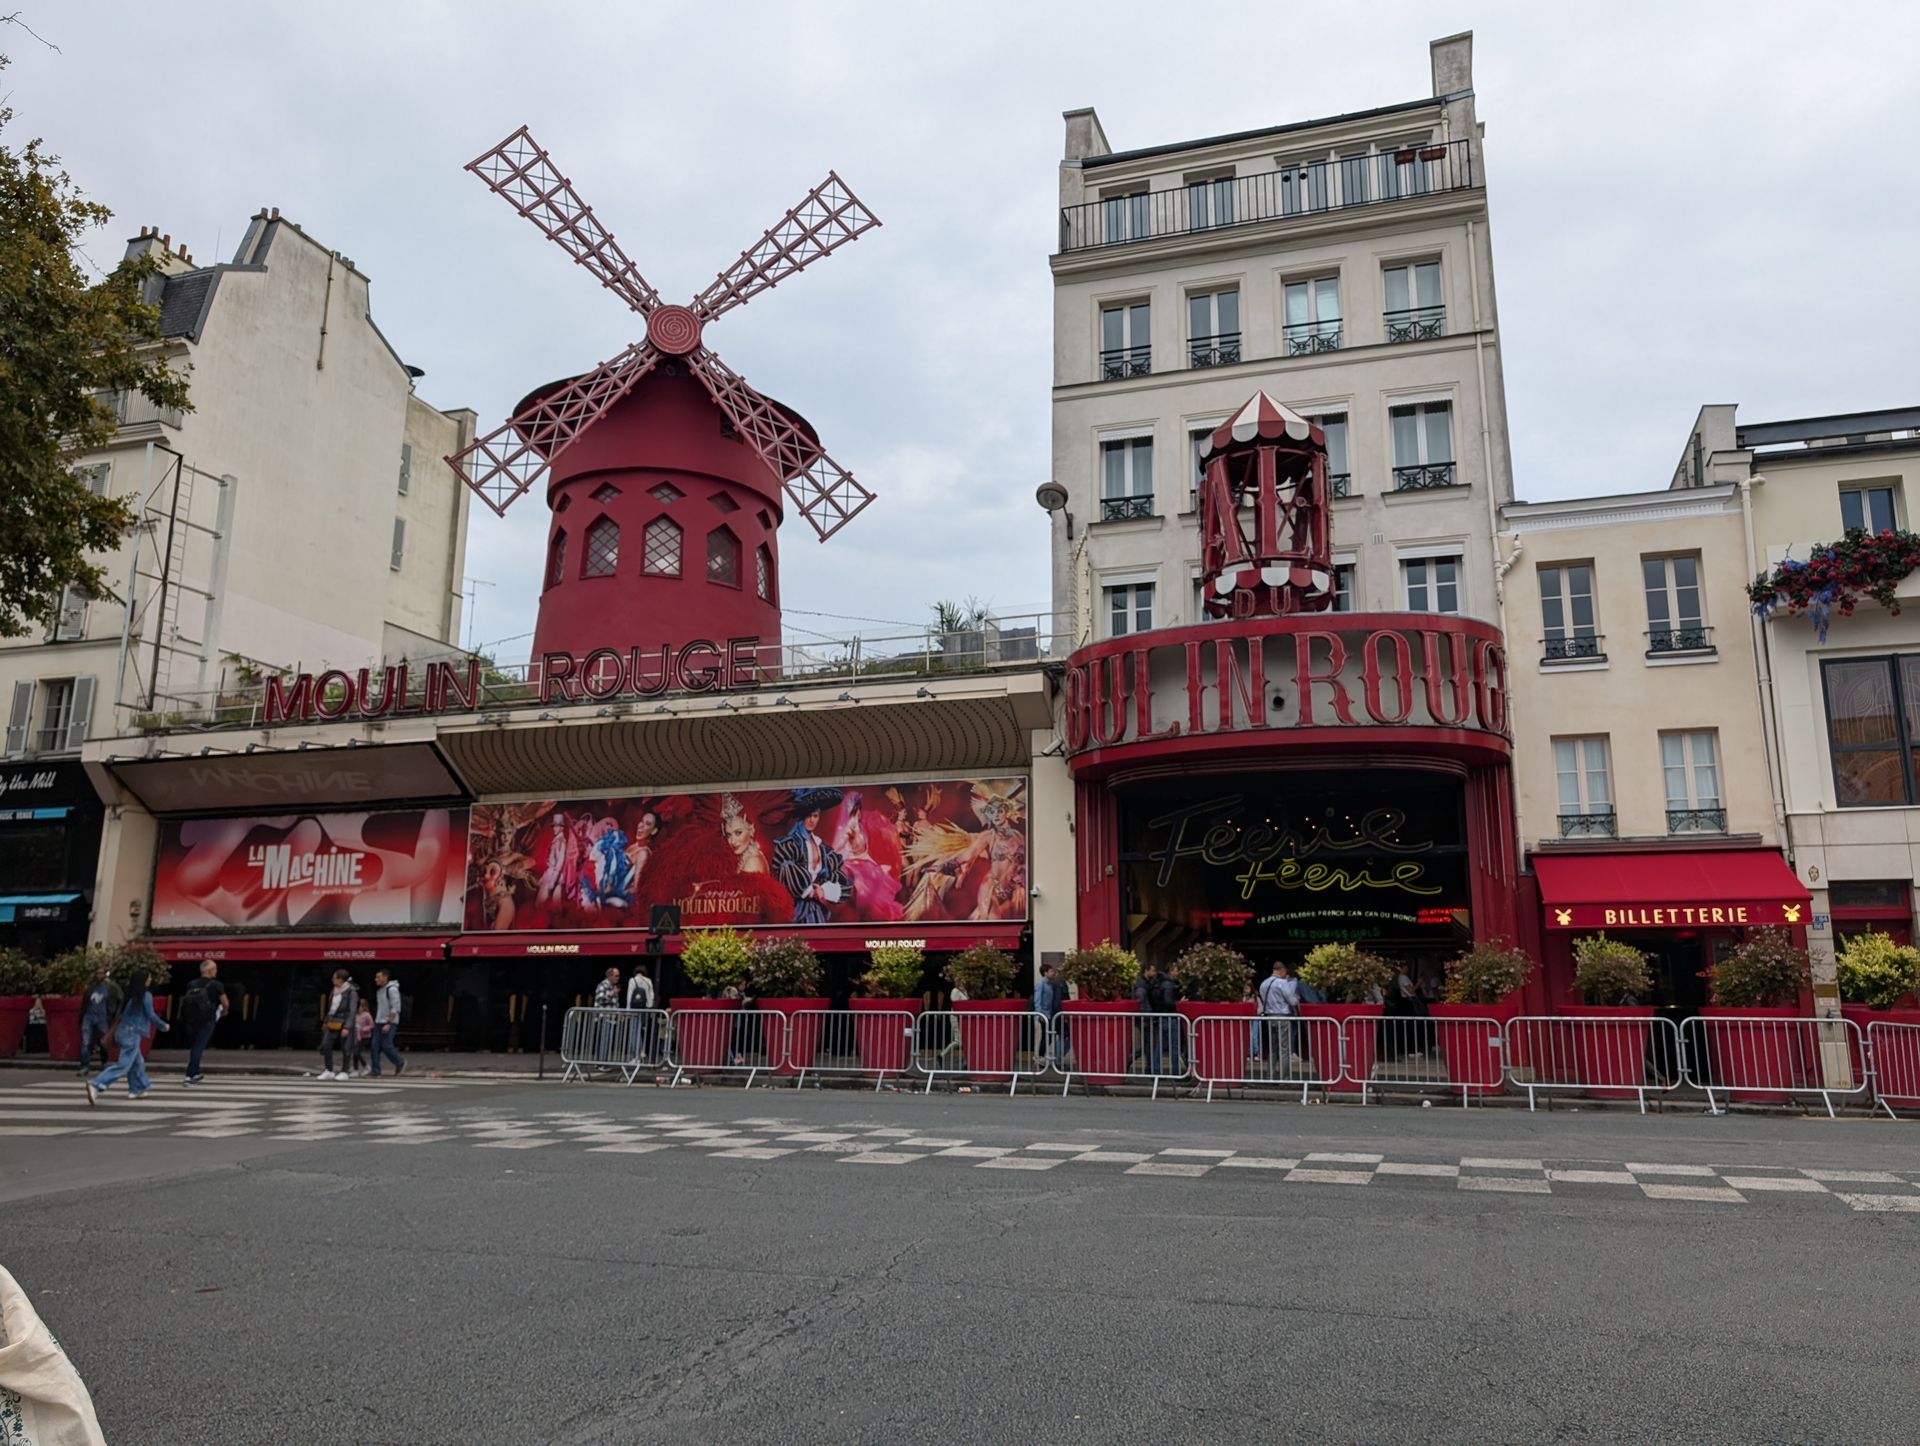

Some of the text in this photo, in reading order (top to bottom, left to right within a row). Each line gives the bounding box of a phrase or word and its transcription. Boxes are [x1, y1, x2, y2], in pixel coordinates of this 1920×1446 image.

[1234, 586, 1291, 617] DU
[263, 636, 761, 723] MOULIN ROUGE
[1066, 629, 1507, 750] OULIN ROUG
[9, 772, 29, 790] the
[29, 771, 58, 790] Mill
[248, 845, 264, 861] LA
[719, 896, 760, 915] ROUGE
[1318, 909, 1344, 917] FRENCH
[1605, 906, 1748, 925] BILLETTERIE
[1288, 928, 1307, 939] LES
[526, 944, 580, 954] MOULIN ROUGE
[865, 939, 926, 949] MOULIN ROUGE
[323, 950, 376, 960] MOULIN ROUGE
